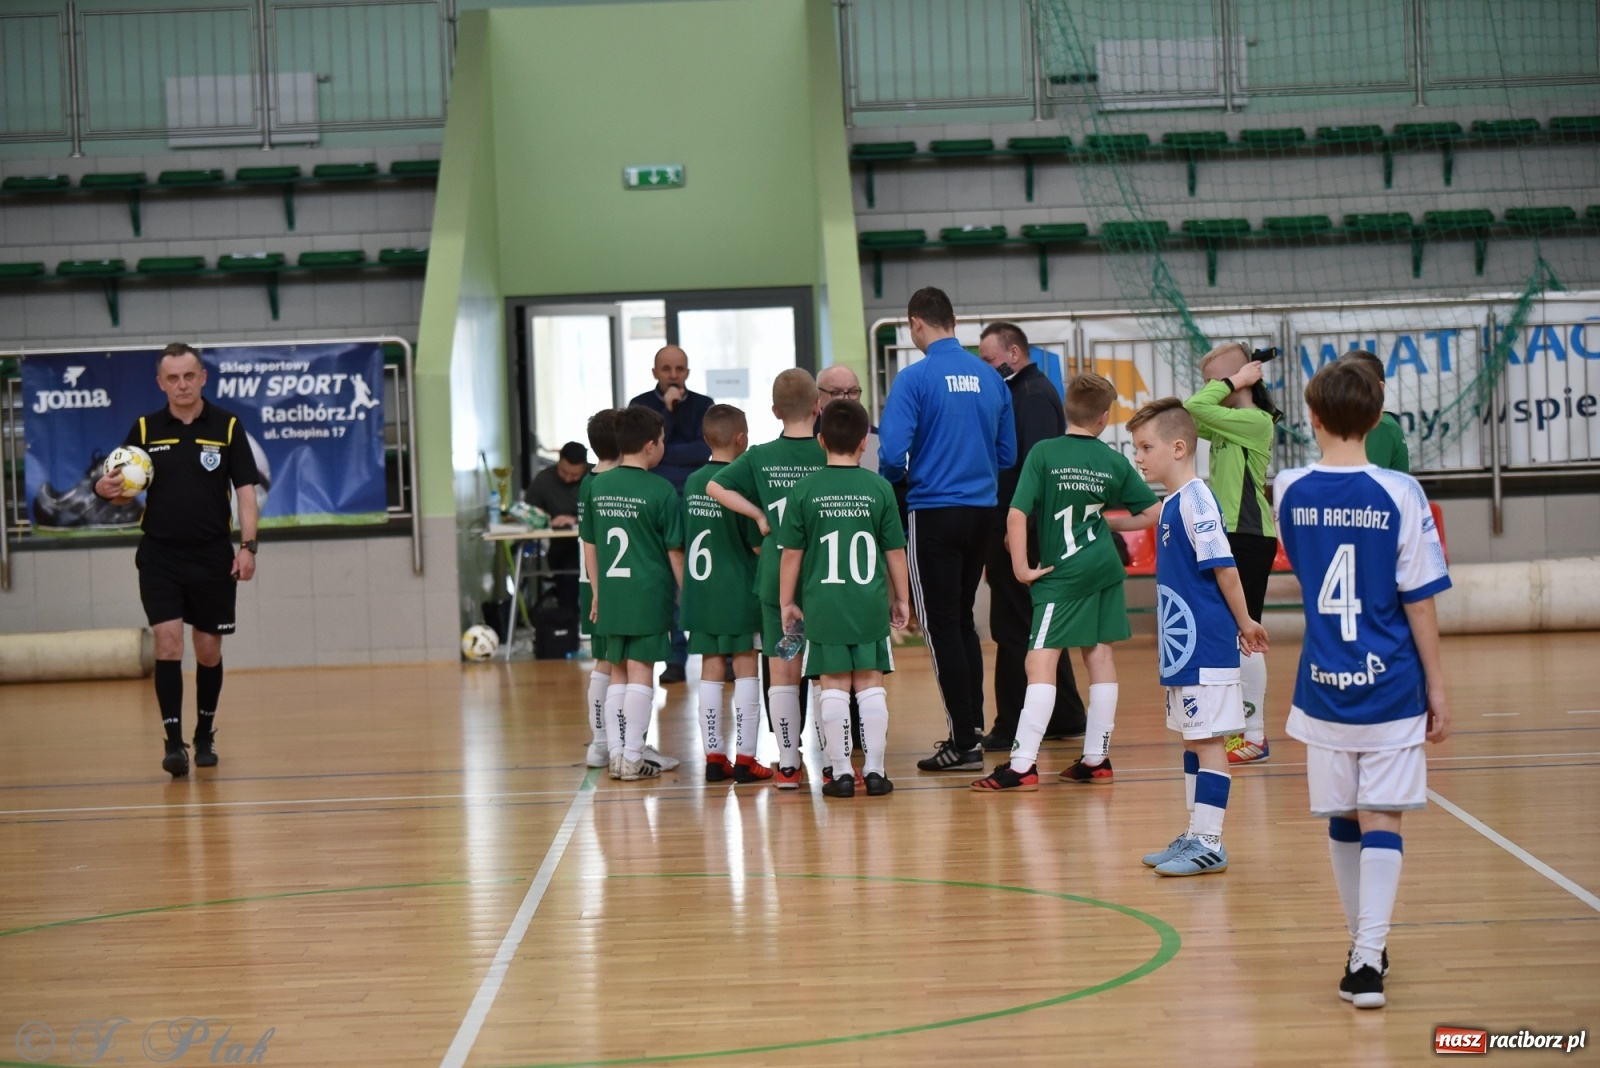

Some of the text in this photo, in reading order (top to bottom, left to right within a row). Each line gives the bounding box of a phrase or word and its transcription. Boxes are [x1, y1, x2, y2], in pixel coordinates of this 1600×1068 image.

[219, 360, 310, 374] Sklep sportowy
[216, 373, 348, 398] MW SPORT
[944, 375, 981, 393] TRENER
[261, 403, 346, 423] Racibórz
[263, 426, 347, 440] ul. Chopina 17
[1056, 482, 1106, 493] TWORKÓW
[818, 507, 871, 518] TWORKÓW
[1323, 504, 1390, 530] RACIBÓRZ
[606, 526, 631, 578] 2
[688, 528, 713, 581] 6
[819, 529, 877, 585] 10
[1317, 543, 1362, 642] 4
[1309, 660, 1376, 690] Empol
